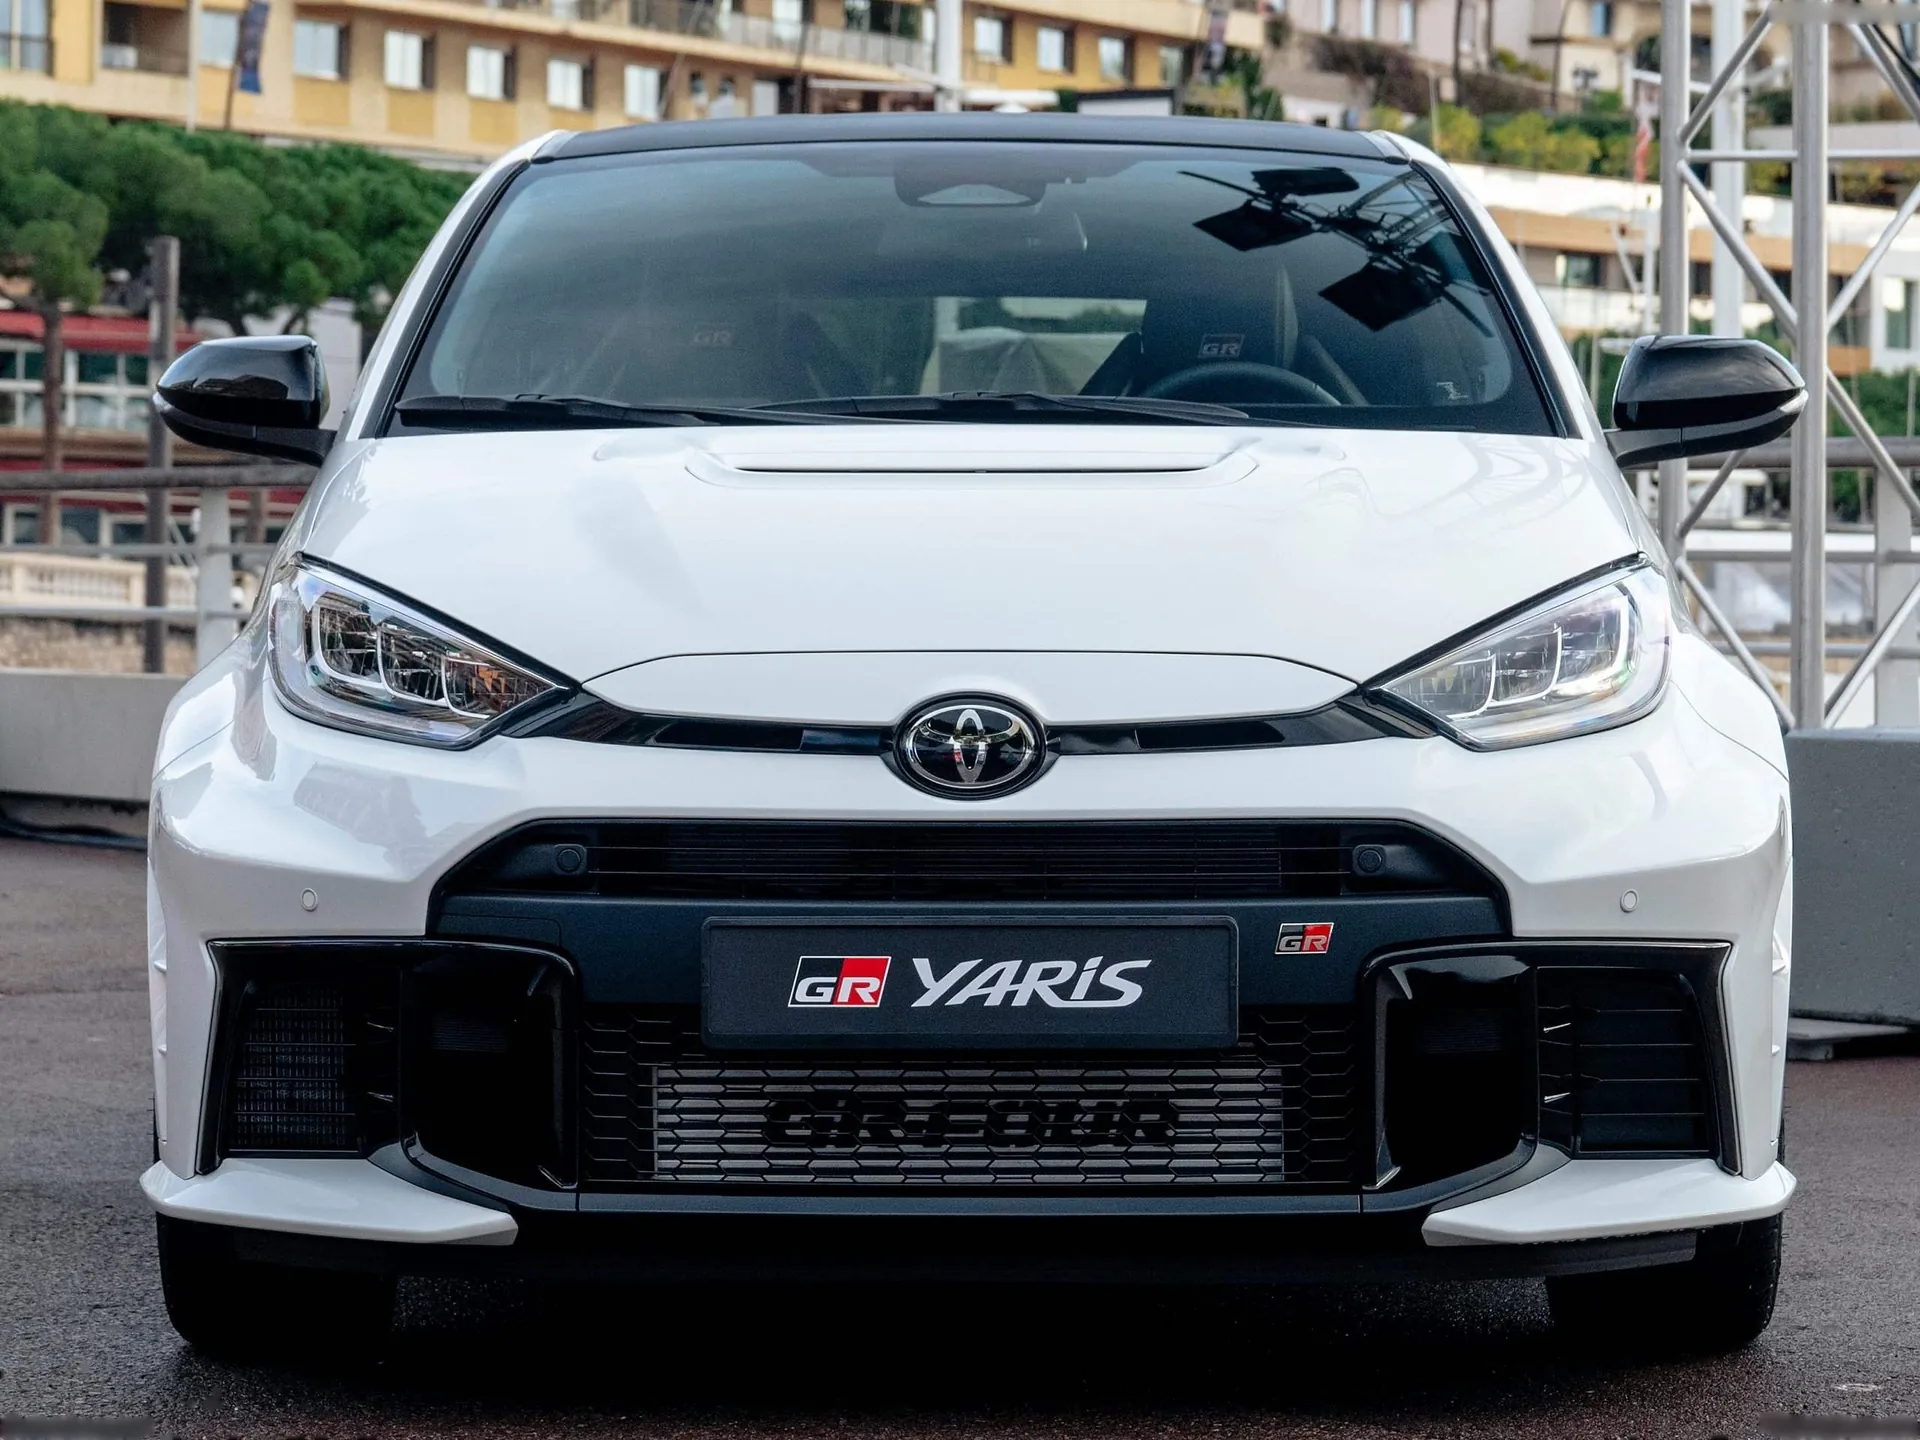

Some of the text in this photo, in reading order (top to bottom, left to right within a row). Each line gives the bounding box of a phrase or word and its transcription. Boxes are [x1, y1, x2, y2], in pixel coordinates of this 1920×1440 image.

[693, 330, 733, 348] GR
[1202, 343, 1241, 357] GR
[1279, 935, 1328, 952] GR
[795, 976, 880, 1003] GR
